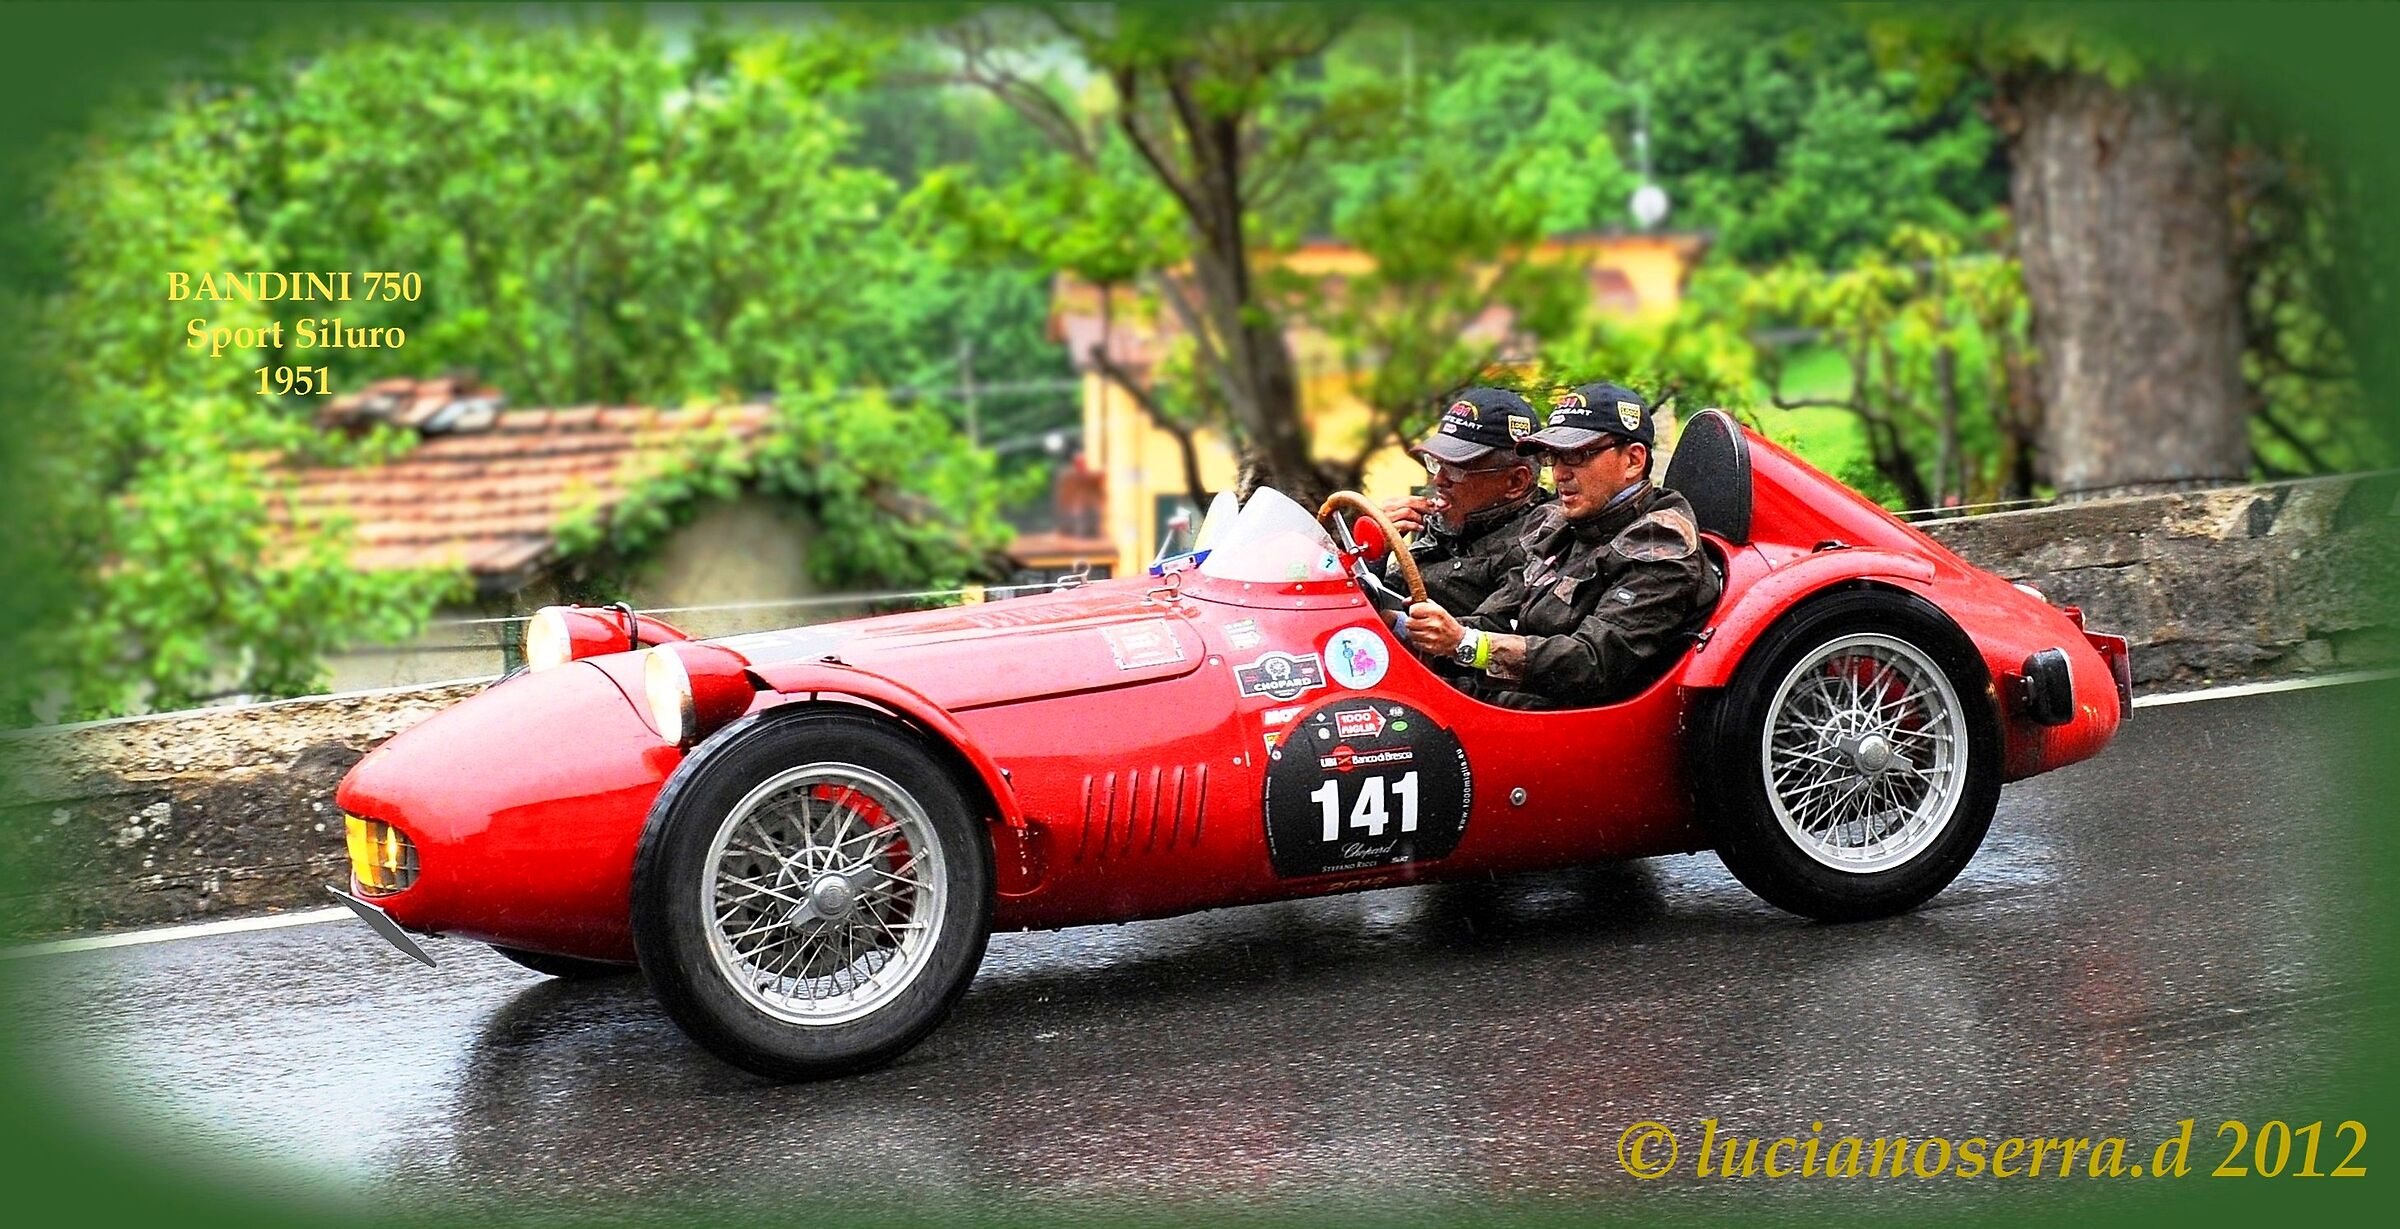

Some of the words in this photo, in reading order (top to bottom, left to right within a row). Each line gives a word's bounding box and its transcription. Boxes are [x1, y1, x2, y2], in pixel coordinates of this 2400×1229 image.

[1253, 677, 1312, 691] CHOPARD
[1341, 712, 1372, 723] 1000
[1341, 723, 1377, 734] MIGLIA
[1352, 754, 1377, 765] Banco
[1385, 751, 1413, 762] Brescia
[1311, 771, 1418, 842] 141
[1341, 839, 1398, 859] Chopard
